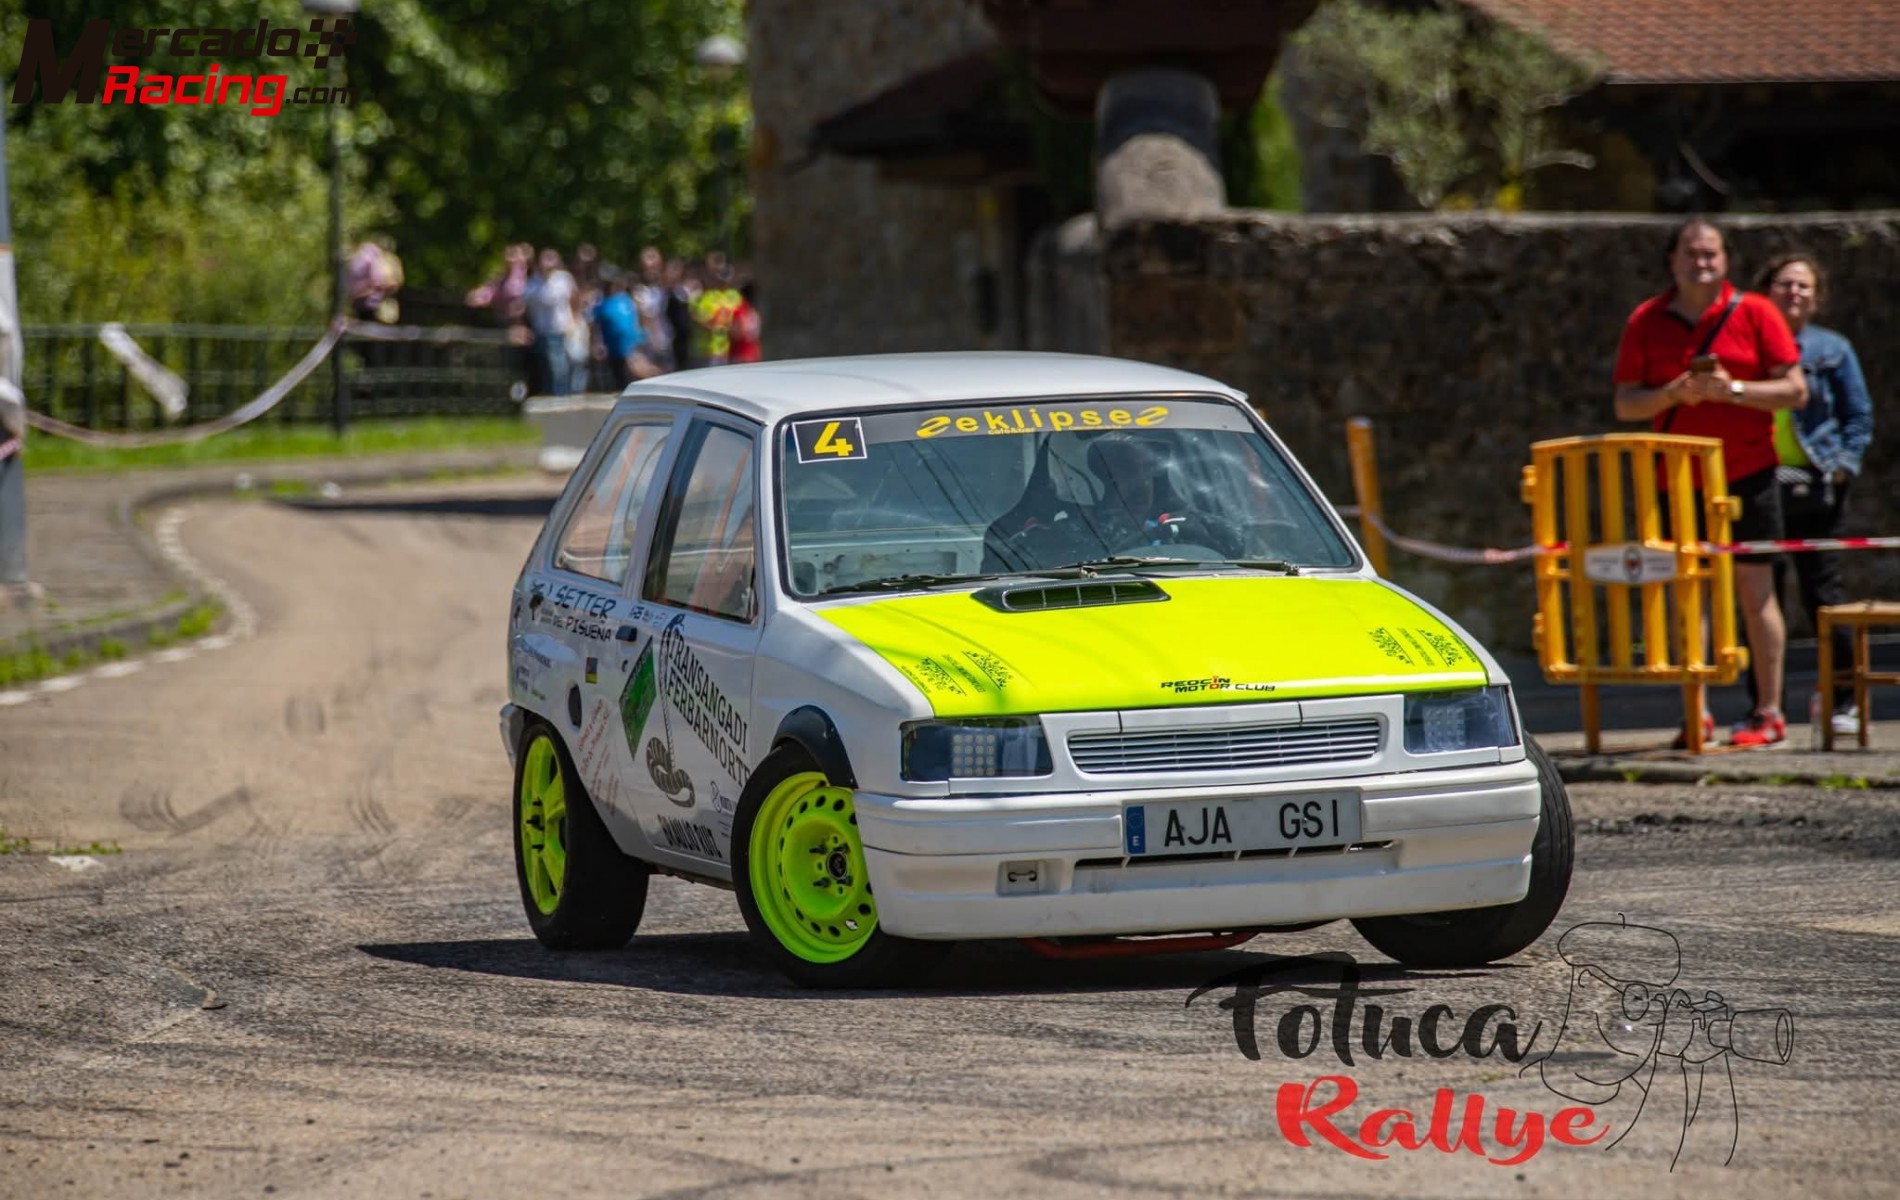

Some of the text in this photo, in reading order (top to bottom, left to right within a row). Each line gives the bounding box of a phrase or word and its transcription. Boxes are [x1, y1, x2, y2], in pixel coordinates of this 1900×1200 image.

[955, 408, 1132, 432] eklipse
[814, 422, 854, 457] 4
[554, 585, 616, 618] SETTER
[1175, 683, 1231, 693] MOTOR
[1164, 799, 1339, 847] AJA GSI
[1132, 835, 1140, 847] E
